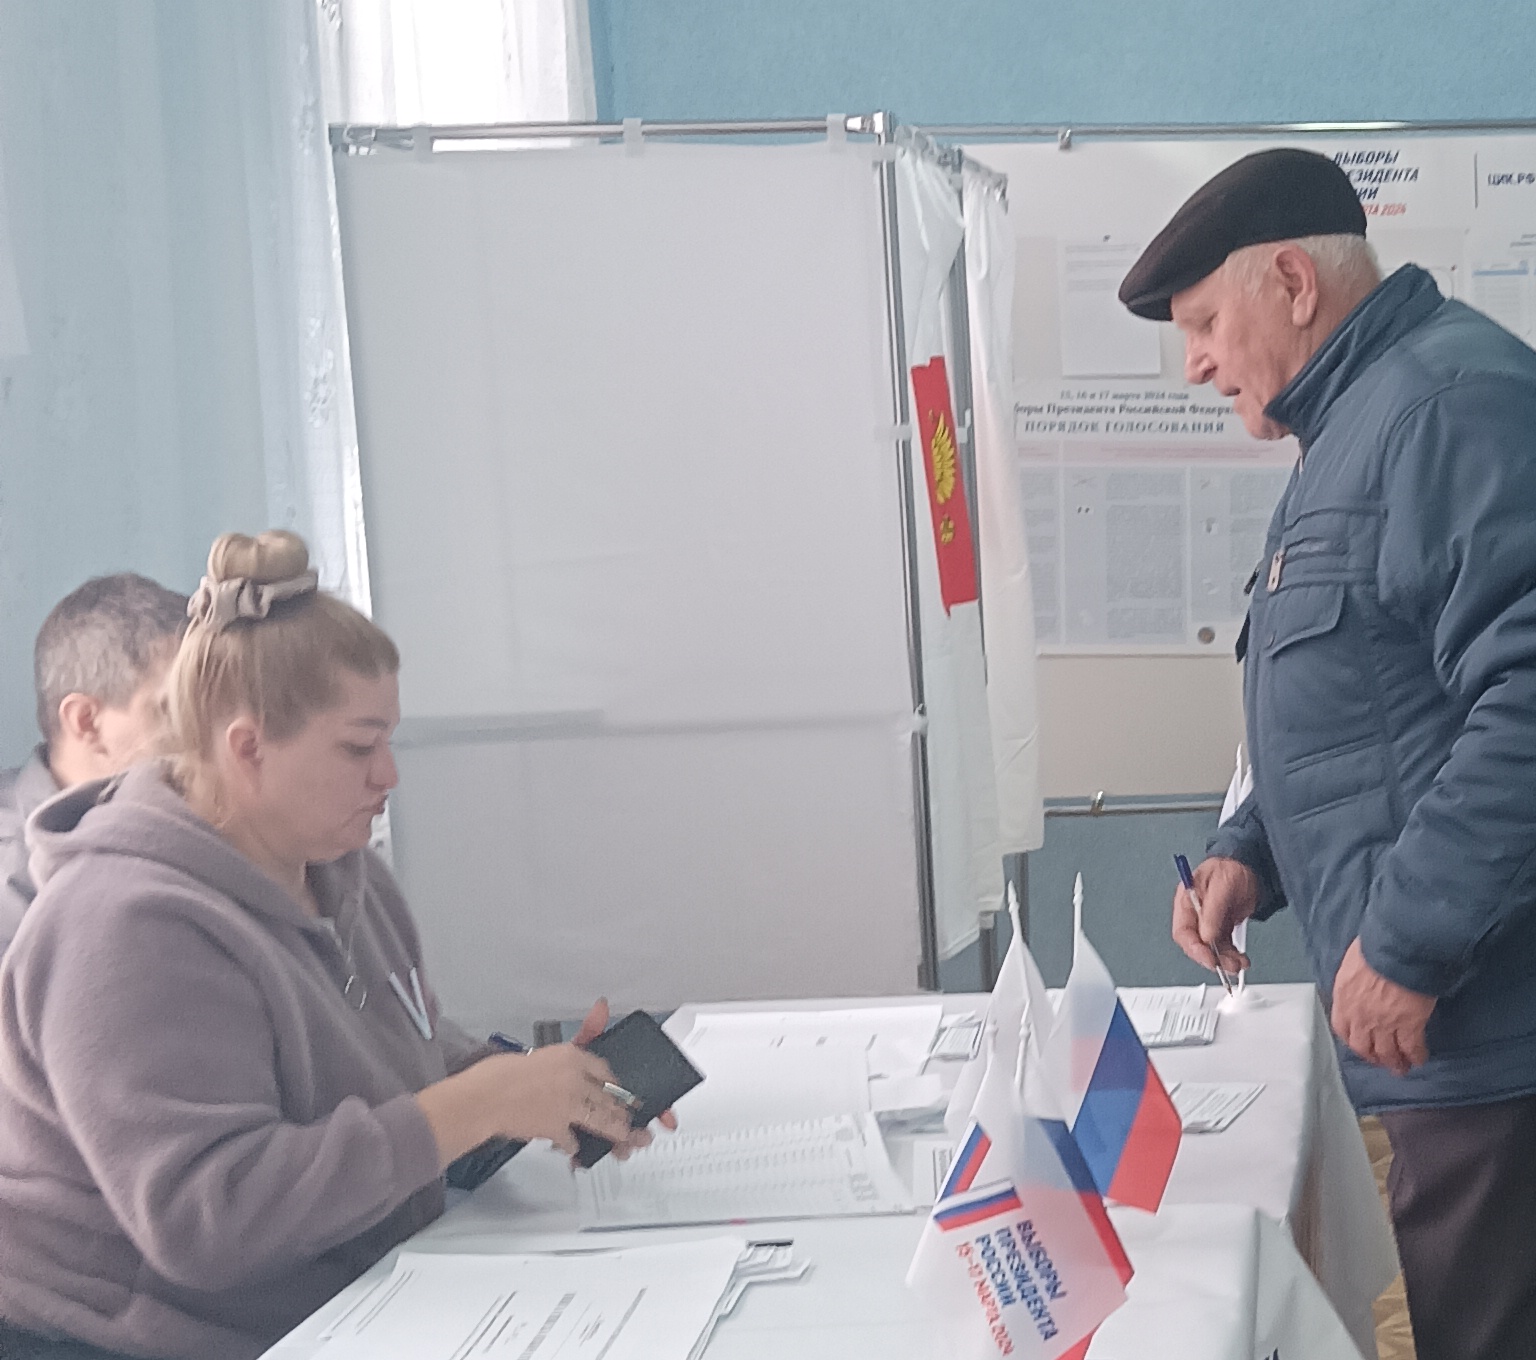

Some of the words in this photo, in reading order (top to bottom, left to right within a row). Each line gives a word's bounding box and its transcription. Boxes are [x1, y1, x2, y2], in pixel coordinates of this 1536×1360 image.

[1025, 420, 1099, 433] ПОРЯДОК
[1104, 420, 1225, 433] ГОЛОСОВАНИЯ
[975, 1234, 1016, 1308] РОССИИ
[995, 1226, 1058, 1341] ПРЕЗИДЕНТА
[1016, 1219, 1067, 1301] ВЫБОРЫ
